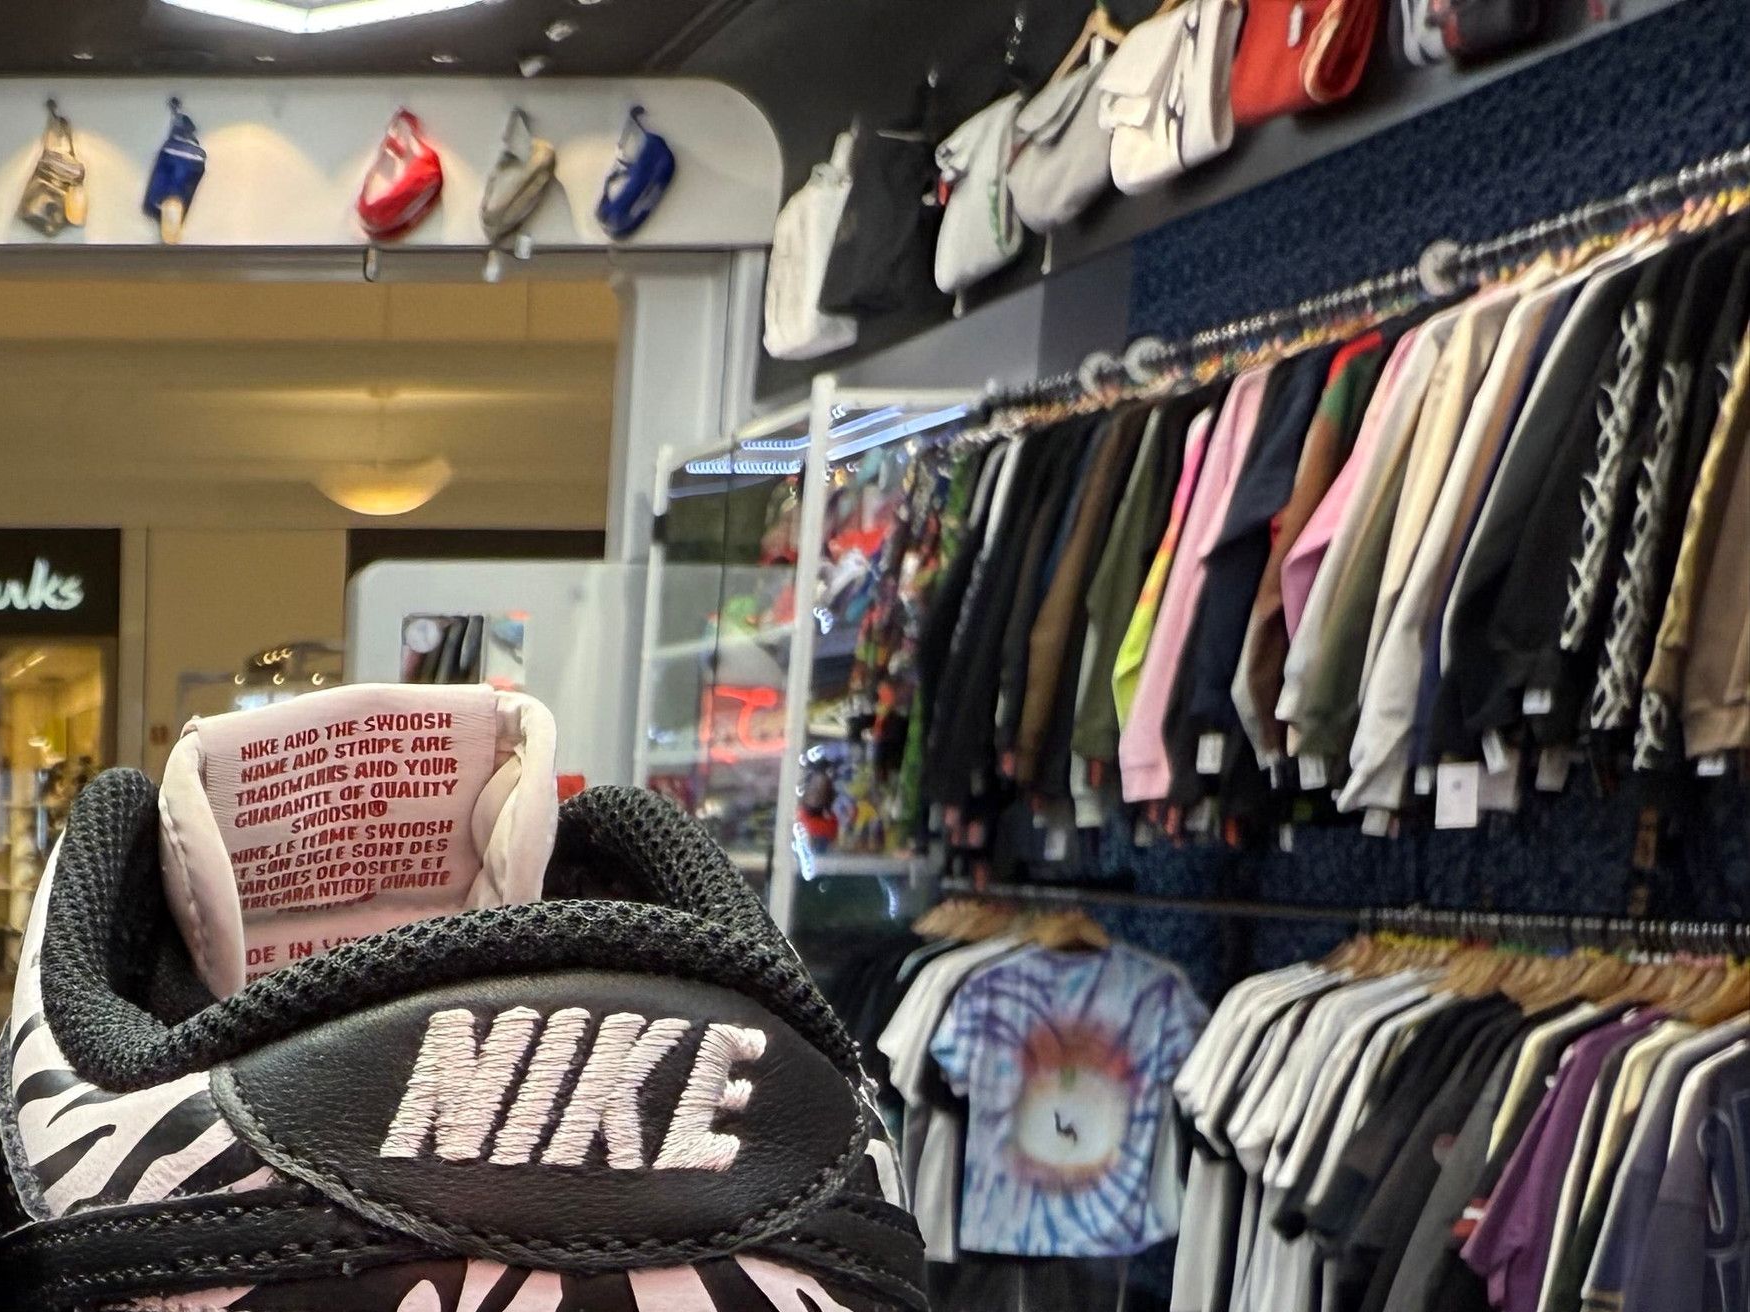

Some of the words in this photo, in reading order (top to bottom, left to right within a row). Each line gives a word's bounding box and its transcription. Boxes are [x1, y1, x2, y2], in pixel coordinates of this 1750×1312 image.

[240, 738, 279, 761] NIKE
[284, 728, 320, 751] AND
[325, 720, 358, 740] THE
[364, 712, 453, 732] SWOOSH
[240, 757, 289, 784] NAME
[292, 747, 329, 770] AND
[334, 737, 405, 759] STRIPE
[410, 736, 454, 754] ARE
[234, 764, 349, 807] TRADEMARKS
[353, 759, 399, 780] AND
[403, 757, 459, 777] YOUR
[339, 784, 366, 801] OF
[370, 778, 460, 800] QUALITY
[364, 819, 454, 840] SWOOSH
[255, 857, 292, 877] SON
[352, 840, 406, 860] SONT
[409, 838, 449, 854] DES
[288, 940, 313, 960] IN
[379, 1005, 768, 1173] NIKE
